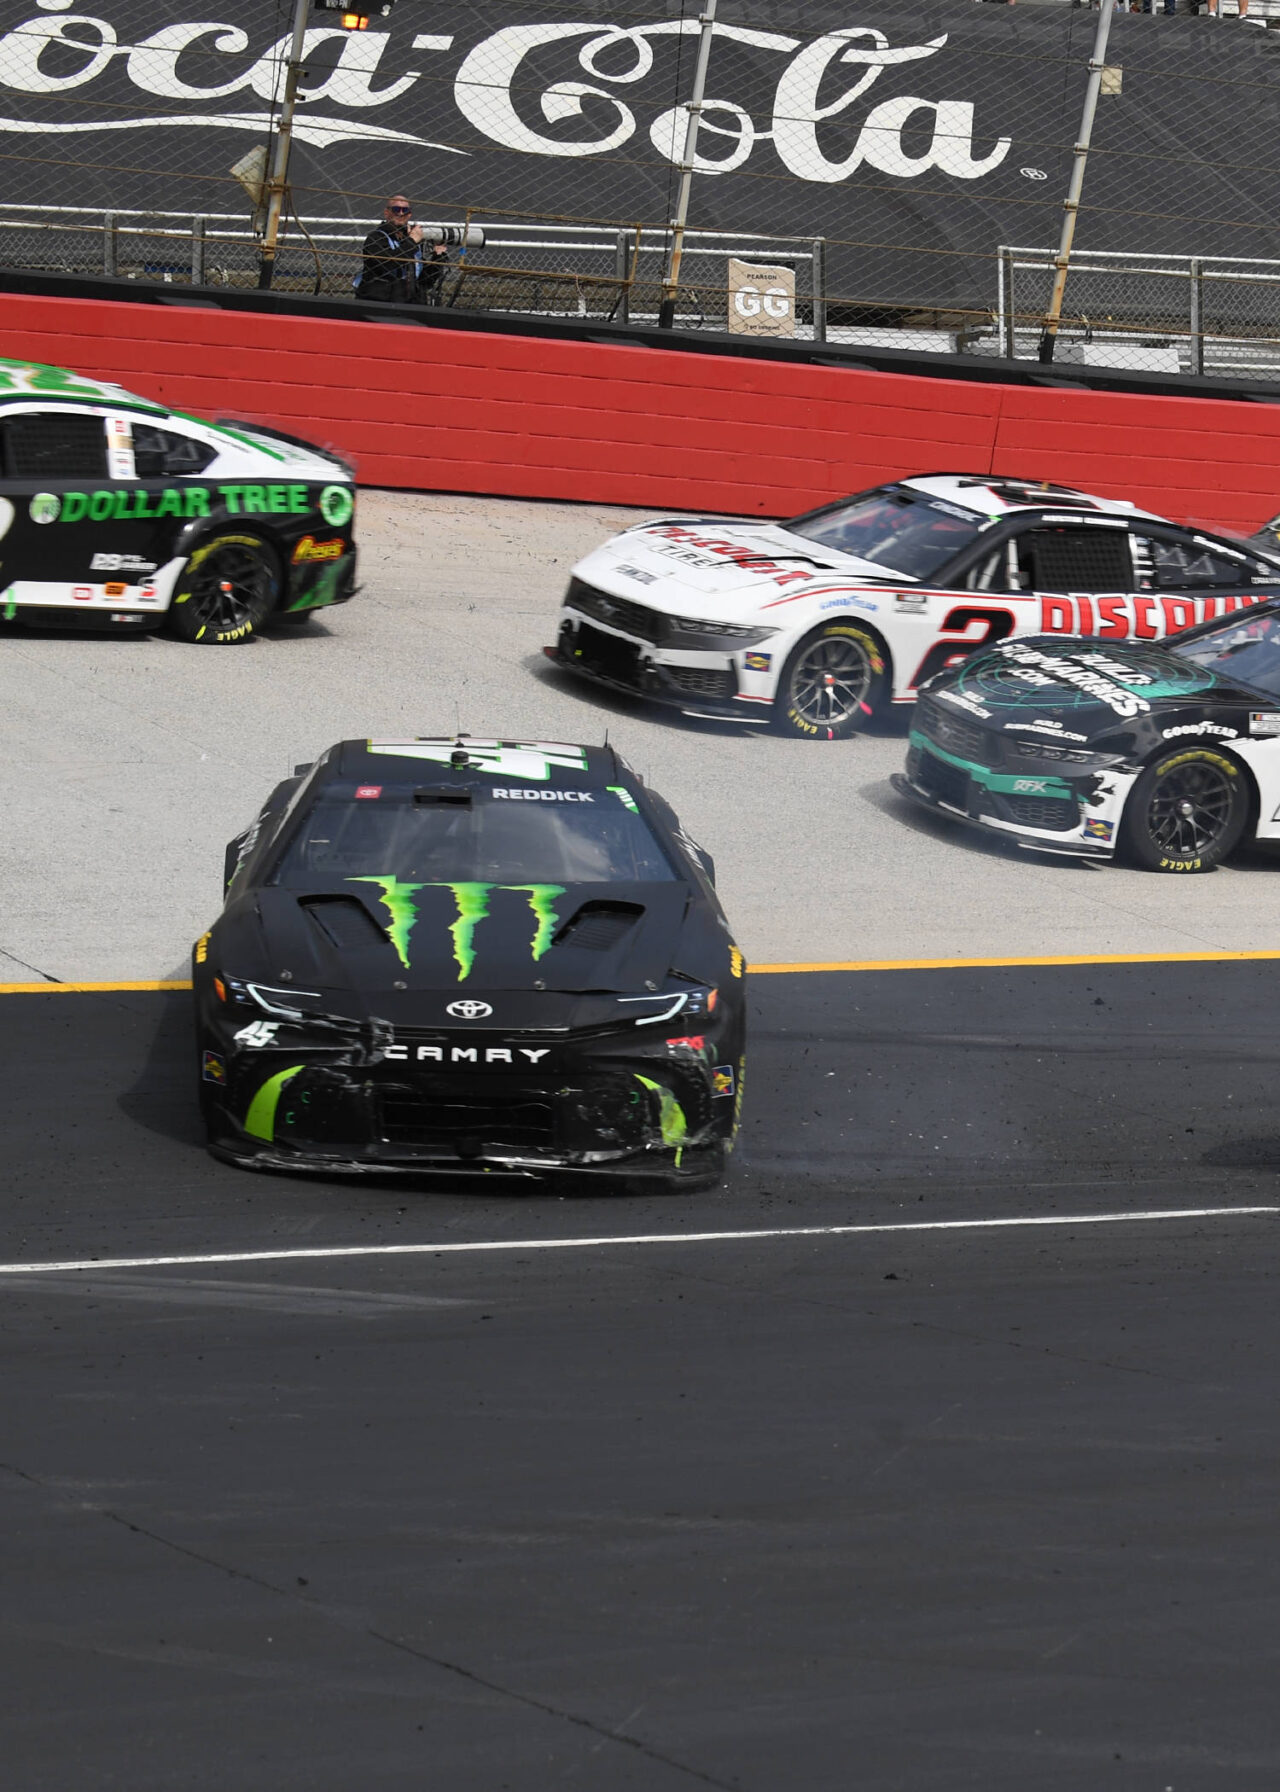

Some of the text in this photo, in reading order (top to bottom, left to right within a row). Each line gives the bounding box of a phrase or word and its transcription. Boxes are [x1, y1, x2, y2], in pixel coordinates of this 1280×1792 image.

[0, 0, 1011, 183] oca-Cola
[734, 286, 789, 318] GG
[60, 484, 313, 523] DOLLAR TREE
[659, 545, 713, 567] TIRE
[1033, 592, 1272, 642] DISCO
[904, 592, 1017, 690] 2
[1007, 668, 1059, 687] .COM
[1070, 653, 1154, 686] BUILD
[1162, 721, 1239, 740] GOODYEAR
[492, 788, 596, 803] REDDICK
[1160, 857, 1202, 872] EAGLE
[233, 1020, 281, 1048] 45
[384, 1045, 552, 1064] CAMRY
